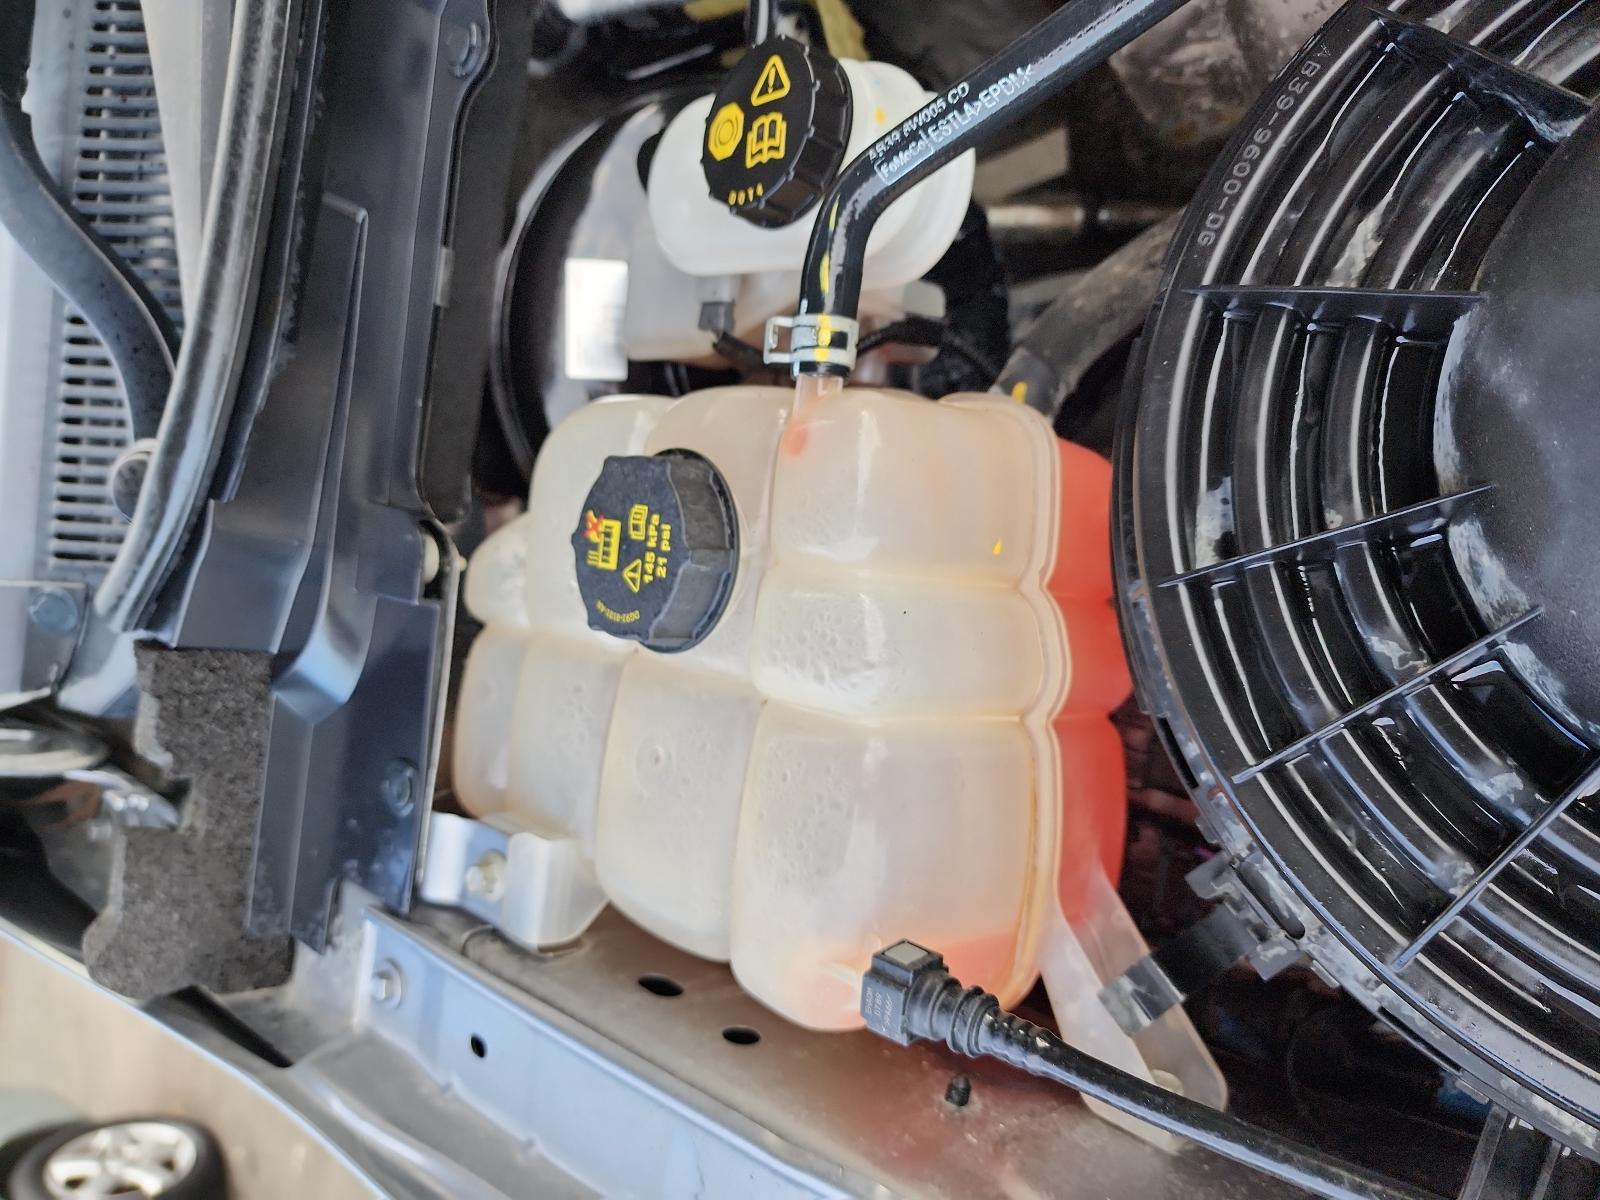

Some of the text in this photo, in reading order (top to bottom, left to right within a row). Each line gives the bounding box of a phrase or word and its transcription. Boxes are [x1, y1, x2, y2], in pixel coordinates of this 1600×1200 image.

[643, 514, 660, 583] 145 kPa
[656, 523, 671, 578] 21 psi
